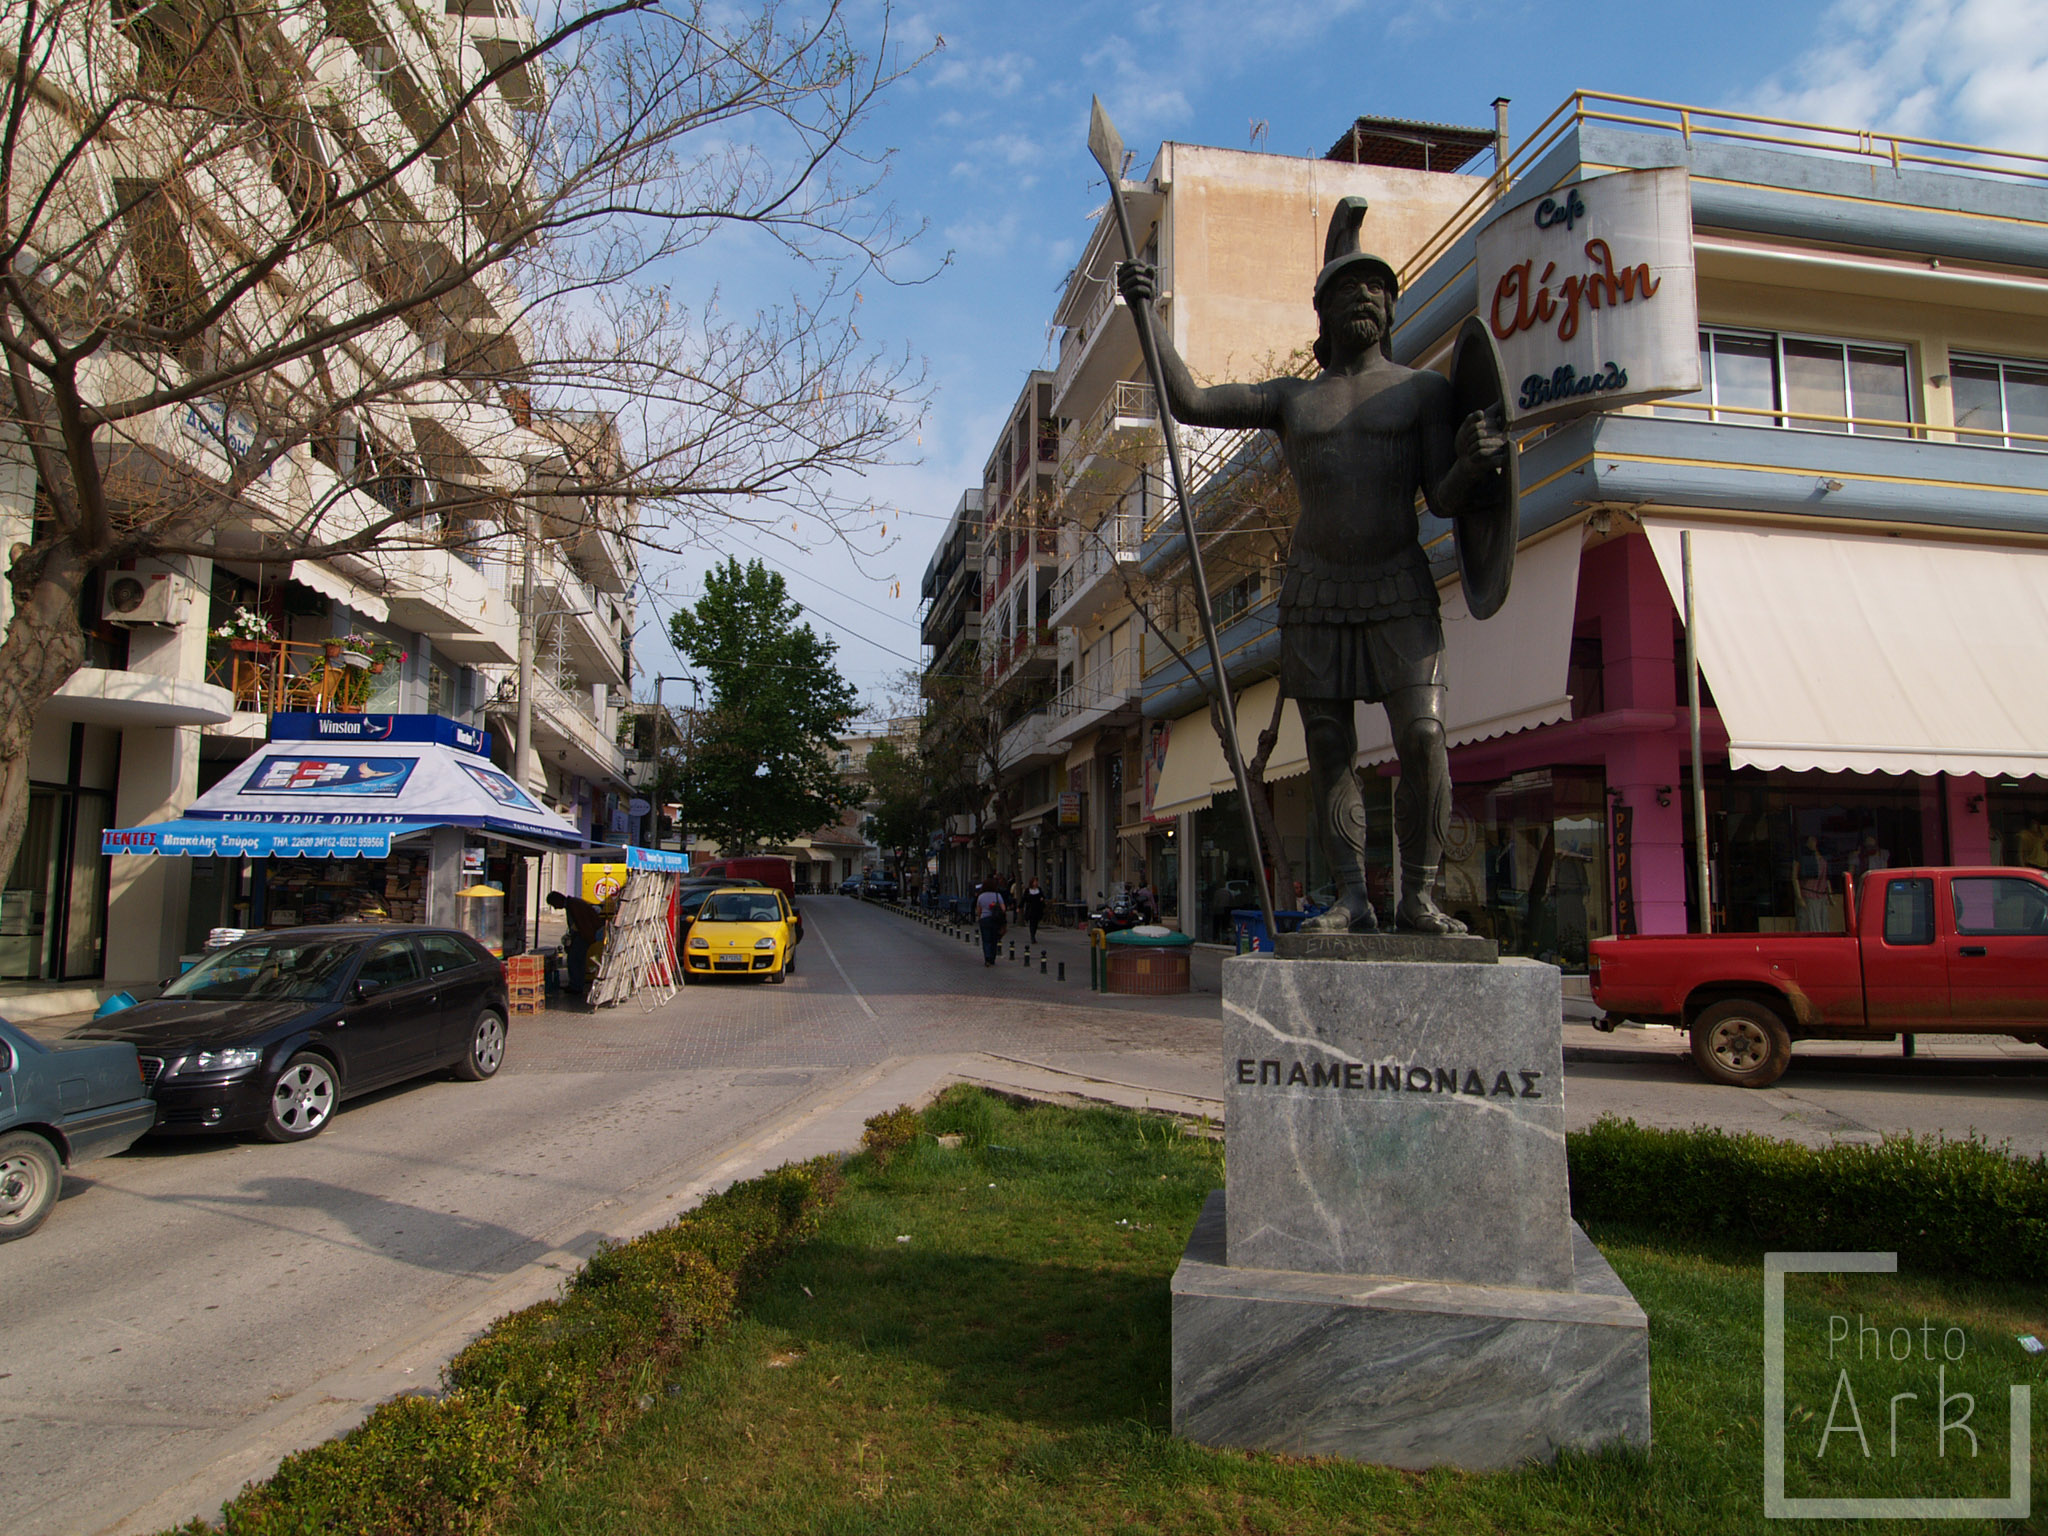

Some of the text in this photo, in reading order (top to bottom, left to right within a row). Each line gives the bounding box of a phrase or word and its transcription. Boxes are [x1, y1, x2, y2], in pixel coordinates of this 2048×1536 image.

[1519, 361, 1628, 409] Billiards
[318, 719, 361, 734] Winston
[104, 831, 157, 846] ΤΕΝΤΕΣ
[163, 834, 217, 848] Μπακάλης
[221, 834, 259, 849] Σπύρος
[1237, 1058, 1542, 1098] ΕΠΑΜΕΙΝΩΝΔΑΣ
